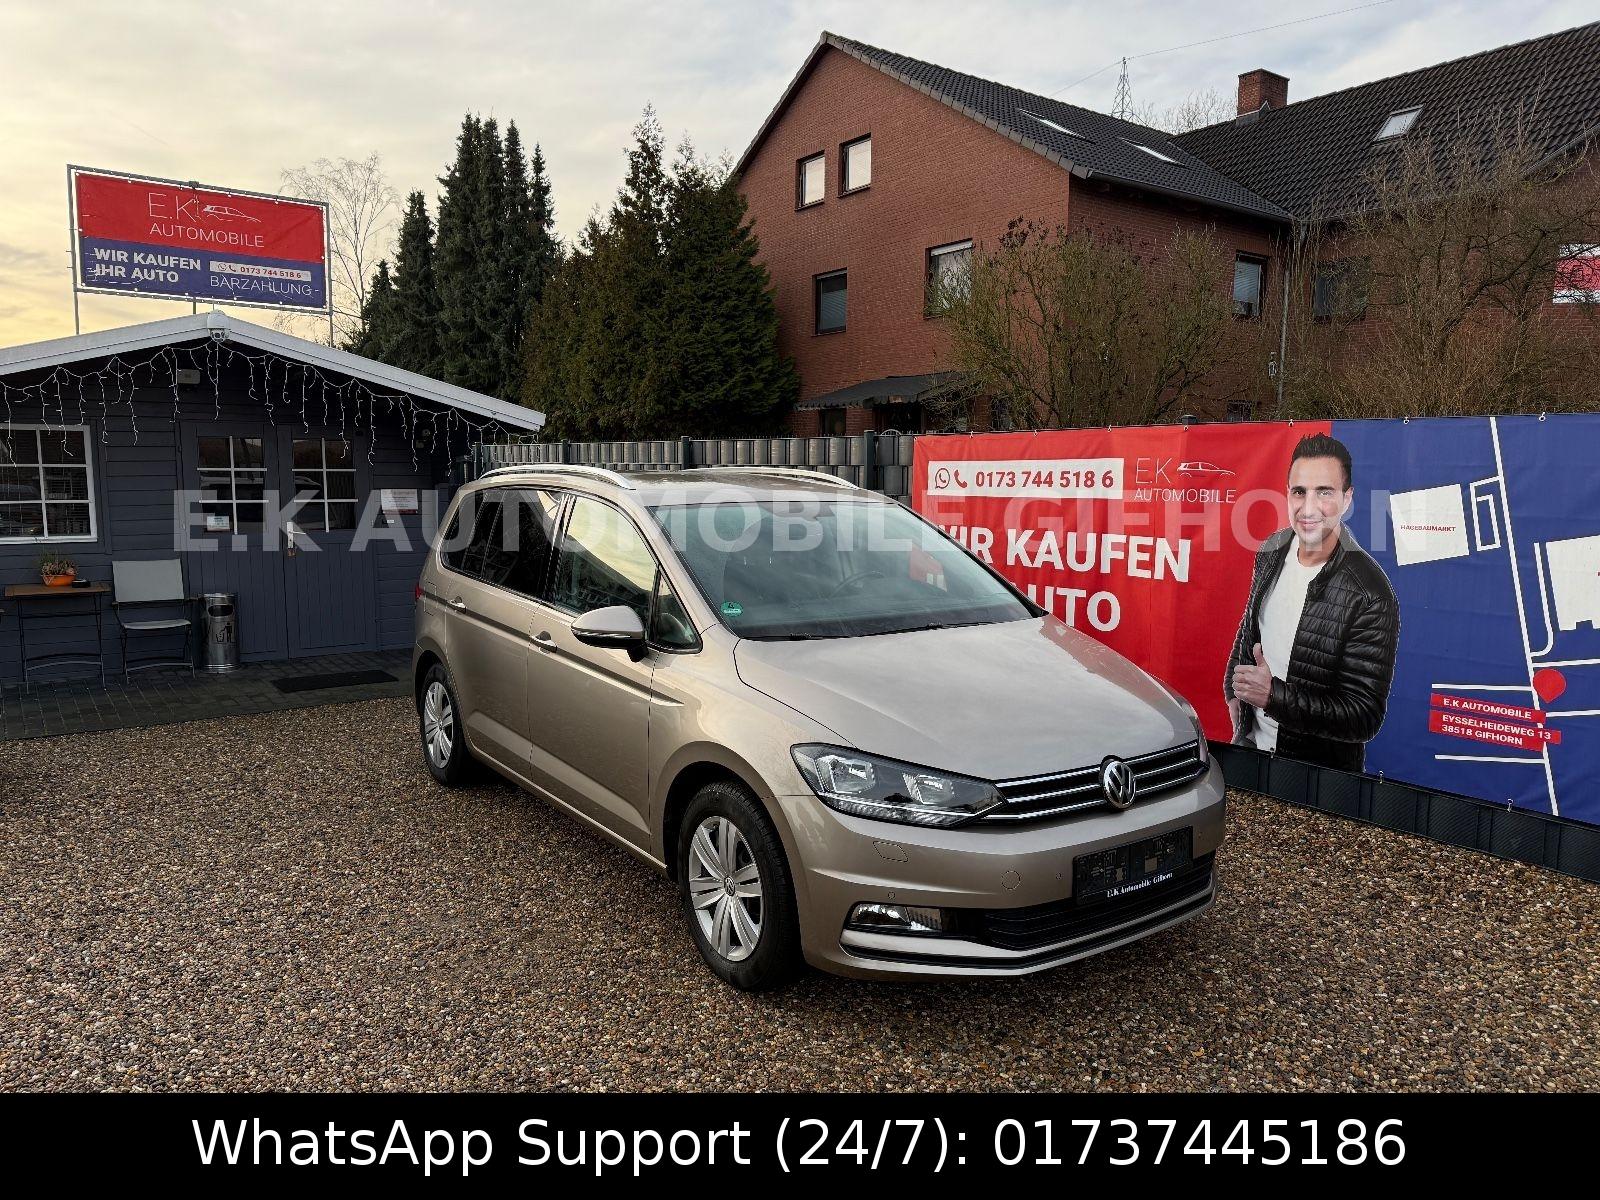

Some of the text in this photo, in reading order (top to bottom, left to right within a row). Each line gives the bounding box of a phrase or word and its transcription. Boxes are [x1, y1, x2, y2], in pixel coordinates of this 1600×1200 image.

[148, 192, 197, 223] E.K
[149, 222, 265, 248] AUTOMOBILE
[94, 247, 201, 271] WIR KAUFEN
[94, 263, 179, 283] IHR AUTO
[240, 266, 302, 279] 0173 744 518 6
[210, 275, 312, 296] BARZAHLUNG
[975, 469, 1115, 489] 0173 744 518 6
[1135, 457, 1173, 484] E.K
[1134, 487, 1237, 504] AUTOMOBILE
[938, 523, 1192, 583] IR KAUFEN
[1443, 698, 1532, 720] E.K AUTOMOBILE
[1442, 714, 1552, 740] EYSSELHEIDEWEG 13
[1442, 724, 1523, 746] 38518 GIFHORN
